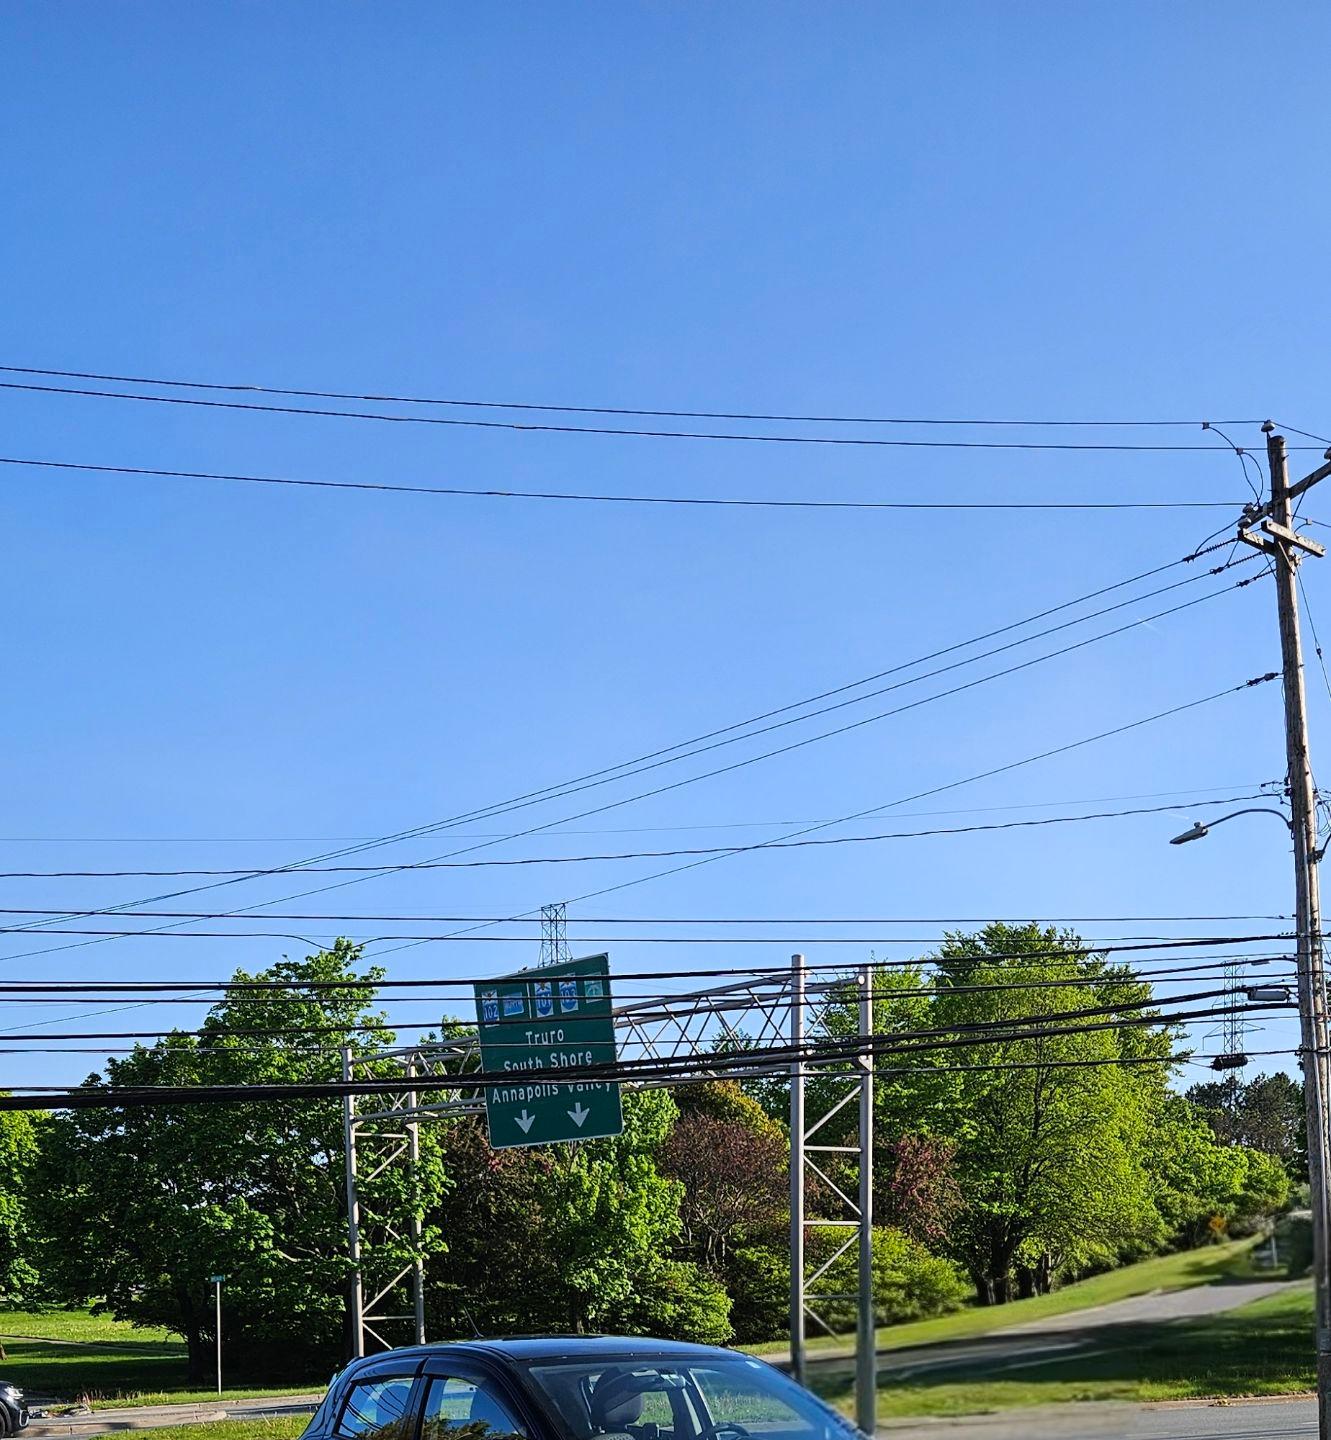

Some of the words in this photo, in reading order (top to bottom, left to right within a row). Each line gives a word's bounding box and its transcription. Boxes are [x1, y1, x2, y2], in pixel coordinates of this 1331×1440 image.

[525, 1029, 564, 1046] Truro
[504, 1057, 543, 1071] South
[550, 1050, 592, 1068] Shore
[492, 1084, 559, 1104] Annapolis
